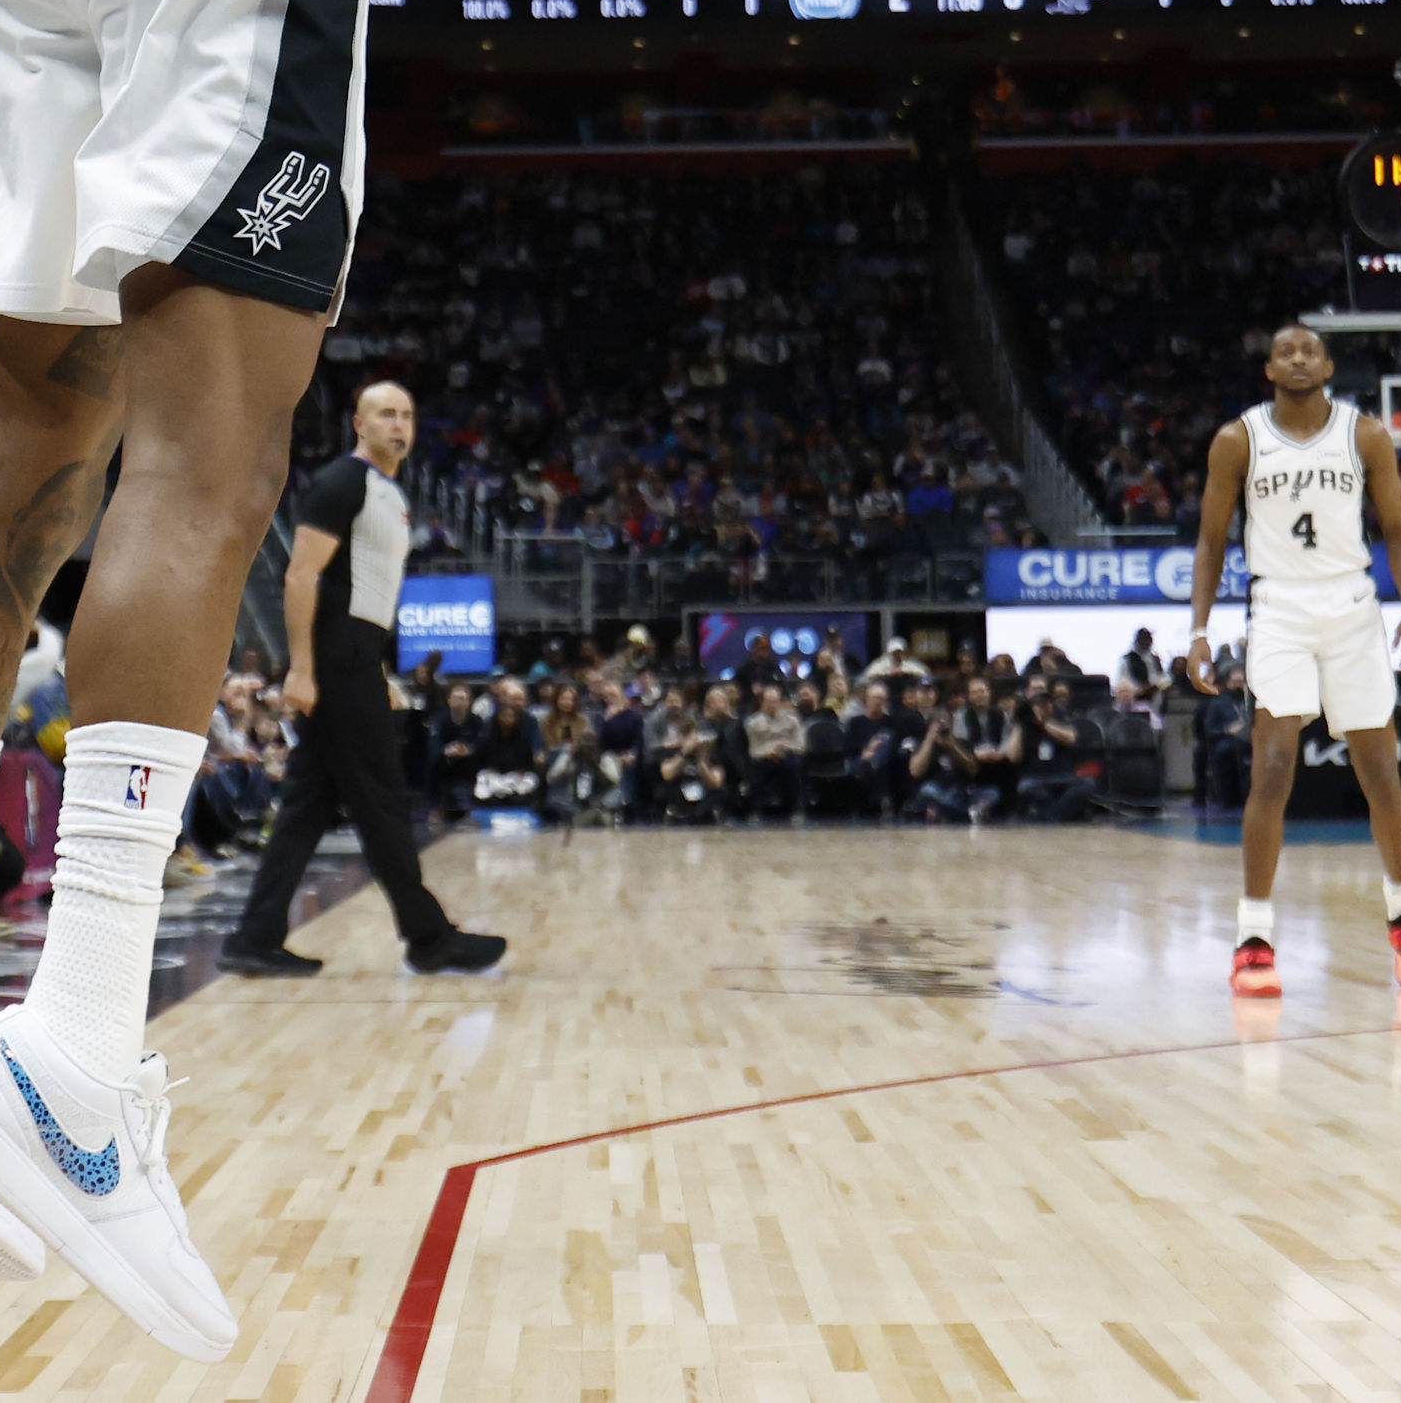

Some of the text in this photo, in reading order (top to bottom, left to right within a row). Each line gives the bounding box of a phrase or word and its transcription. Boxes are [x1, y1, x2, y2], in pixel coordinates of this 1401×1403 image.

[1254, 469, 1354, 503] SPURS
[1291, 511, 1317, 549] 4
[1018, 549, 1151, 587] CURE
[1020, 587, 1119, 601] INSURANCE
[398, 602, 469, 627] CURE
